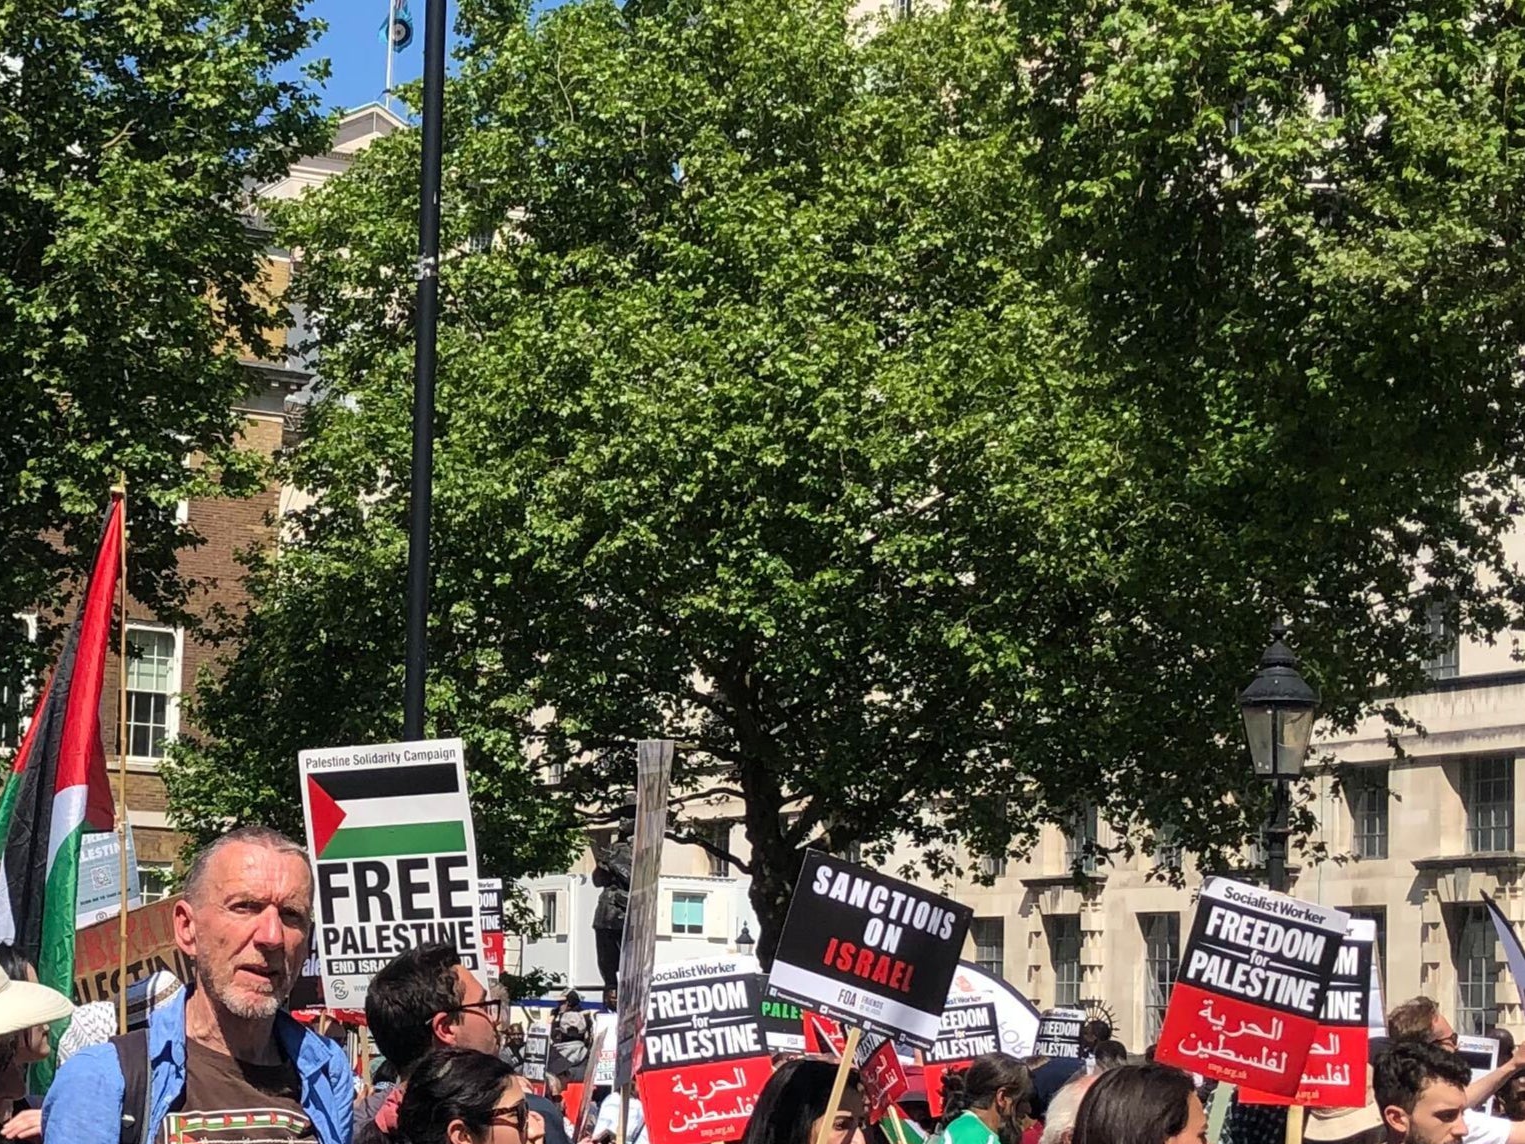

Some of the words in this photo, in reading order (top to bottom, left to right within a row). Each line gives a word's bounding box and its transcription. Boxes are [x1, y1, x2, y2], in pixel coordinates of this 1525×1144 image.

[306, 756, 350, 769] Palestine
[353, 751, 401, 766] Solidarity
[404, 749, 456, 764] Campaign
[317, 855, 473, 924] FREE
[813, 865, 955, 940] SANCTIONS
[1224, 886, 1279, 914] Socialist
[1280, 902, 1326, 925] Worker
[323, 920, 476, 955] PALESTINE
[863, 918, 903, 954] ON
[1205, 906, 1326, 965] FREEDOM
[332, 960, 356, 974] END
[696, 962, 737, 976] Worker
[824, 937, 915, 992] ISRAEL
[1249, 950, 1270, 968] for
[838, 988, 858, 1008] FOA
[1187, 949, 1320, 1012] PALESTINE
[648, 981, 748, 1020] FREEDOM
[691, 1015, 710, 1029] for
[940, 1007, 990, 1031] EEDOM
[954, 1028, 966, 1038] for
[1039, 1021, 1080, 1036] FREEDOM
[1199, 999, 1284, 1041] الحرية
[646, 1023, 762, 1064] PALESTINE
[1034, 1043, 1080, 1058] PALESTINE
[1178, 1033, 1288, 1074] لفلسطين
[672, 1067, 747, 1100] الحرية
